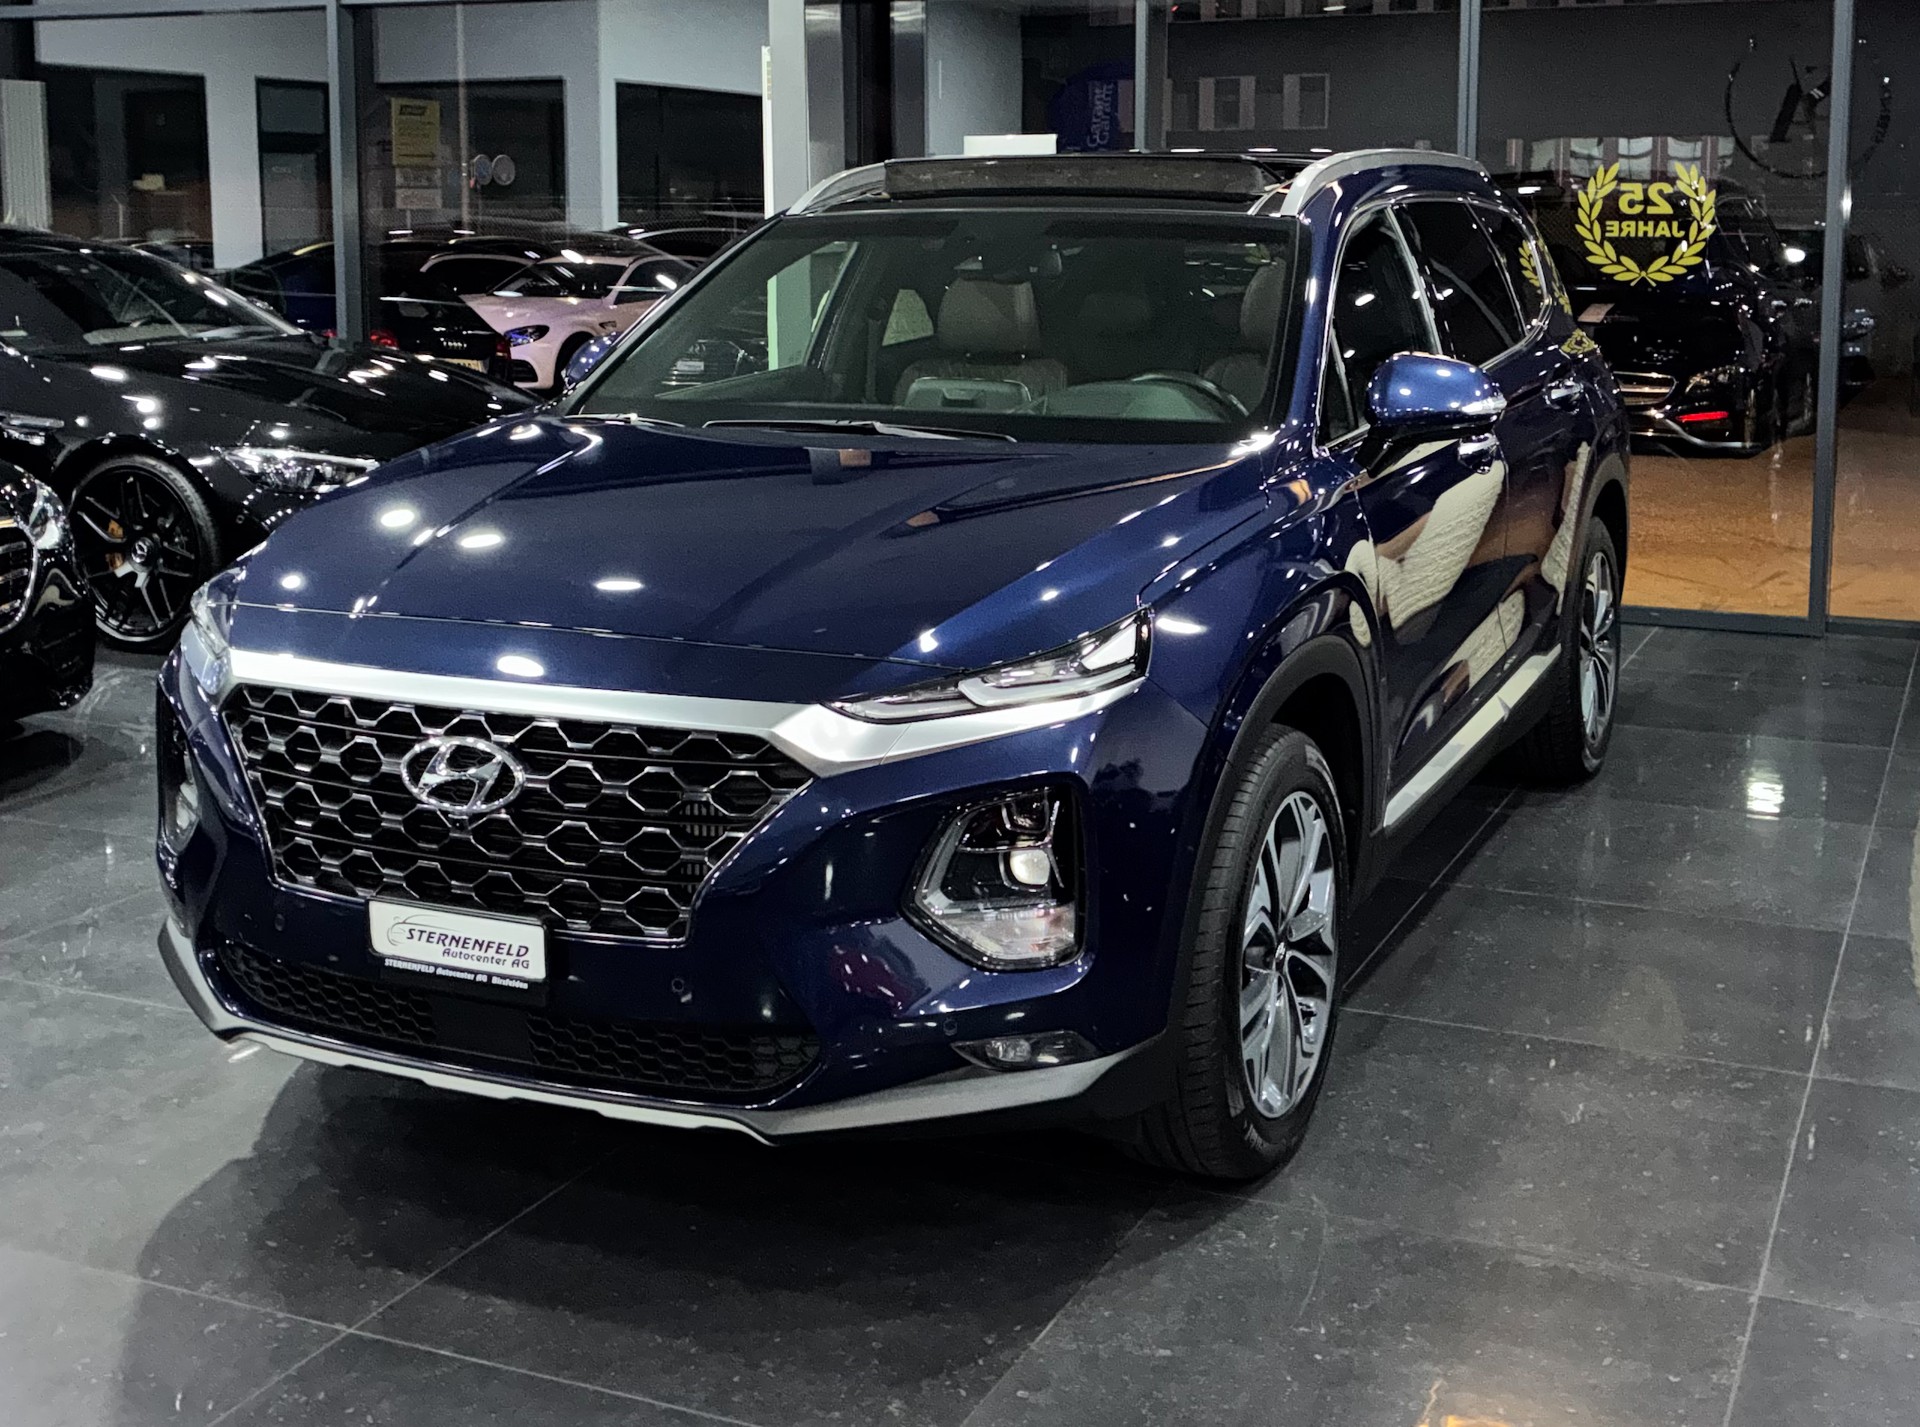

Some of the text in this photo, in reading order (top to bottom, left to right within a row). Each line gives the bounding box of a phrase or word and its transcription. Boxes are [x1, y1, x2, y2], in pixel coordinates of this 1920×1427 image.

[406, 928, 529, 957] STERNENFELD
[384, 958, 435, 974] STERNENFELD
[442, 949, 530, 969] Autocenter AG
